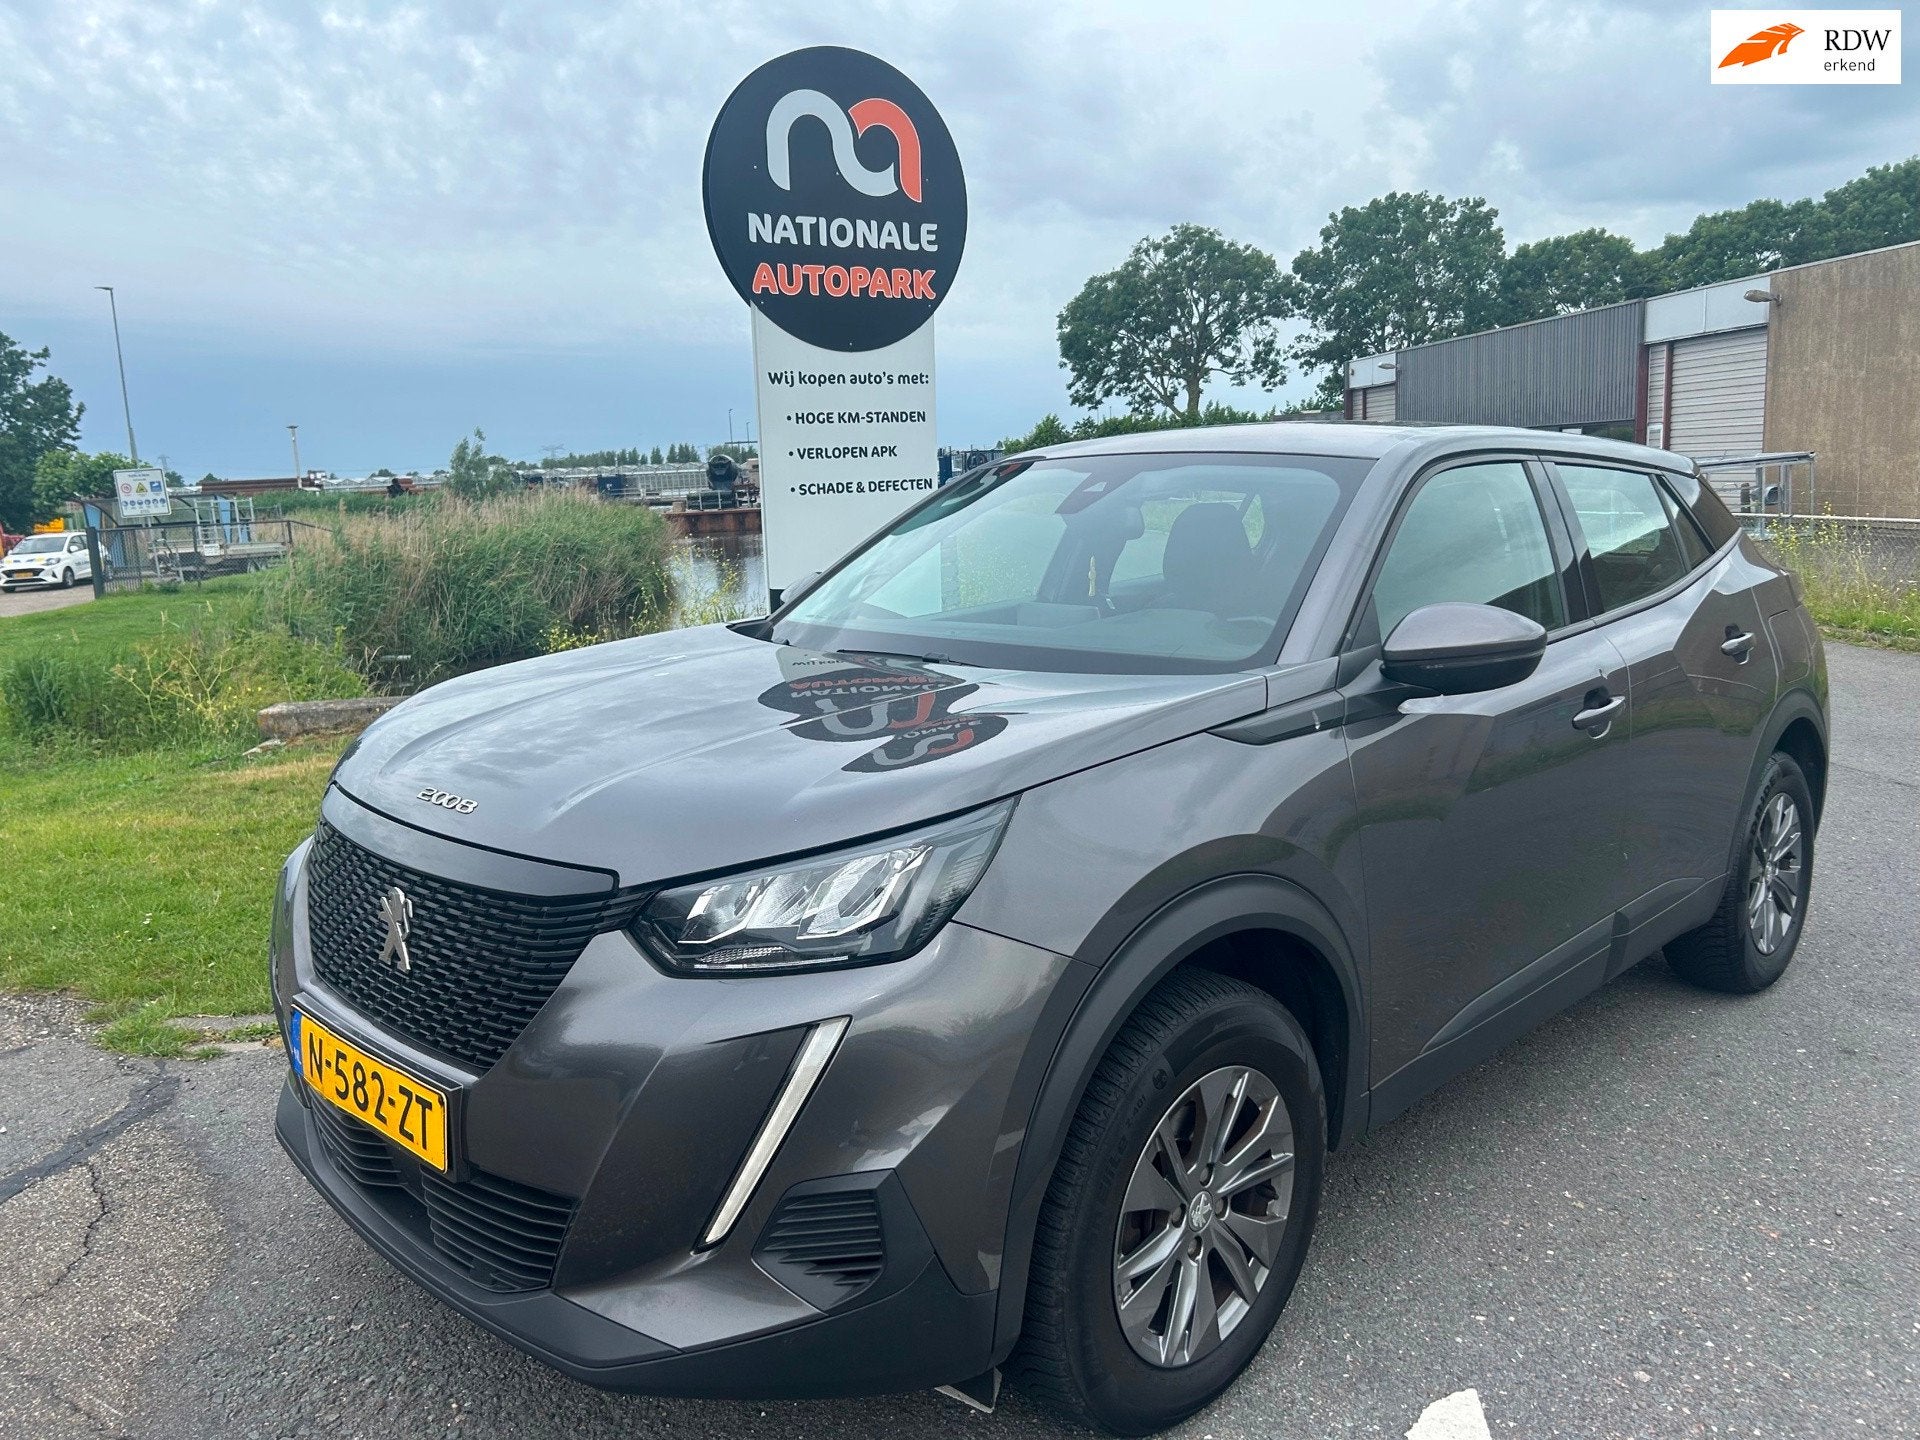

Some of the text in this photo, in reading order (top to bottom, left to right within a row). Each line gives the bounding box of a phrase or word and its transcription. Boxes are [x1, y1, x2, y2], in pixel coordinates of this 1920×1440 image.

[747, 212, 938, 252] NATIONALE
[752, 262, 936, 300] AUTOPARK
[768, 370, 930, 388] Wij kopen auto's met:
[795, 411, 926, 425] HOGE KM-STANDEN
[796, 445, 898, 460] VERLOPEN APK
[798, 478, 933, 496] SCHADE & DEFECTEN
[416, 786, 479, 815] 2008
[308, 1031, 433, 1151] N-582-ZT
